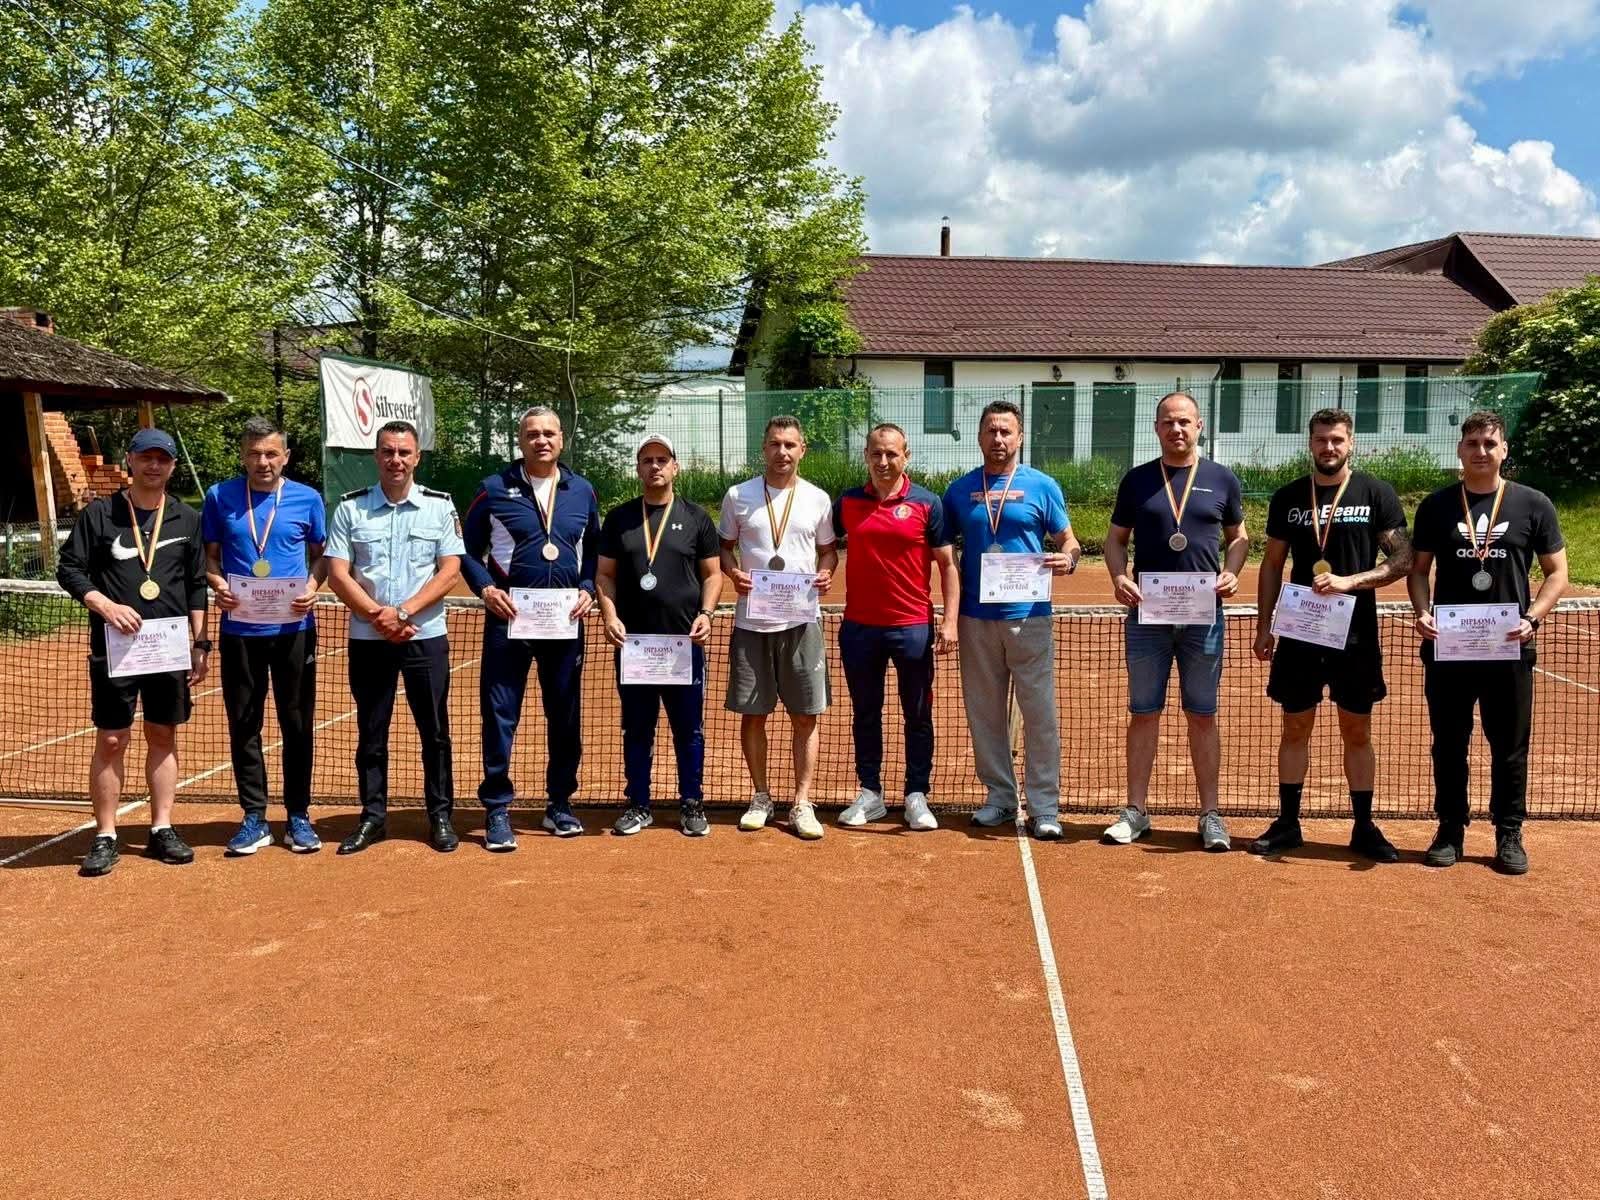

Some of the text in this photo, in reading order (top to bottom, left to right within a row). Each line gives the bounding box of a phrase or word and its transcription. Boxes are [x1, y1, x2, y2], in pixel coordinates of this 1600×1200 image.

[375, 395, 416, 421] Silvester
[1163, 583, 1196, 593] DIPLOMĂ
[1460, 616, 1496, 626] DIPLOMĂ
